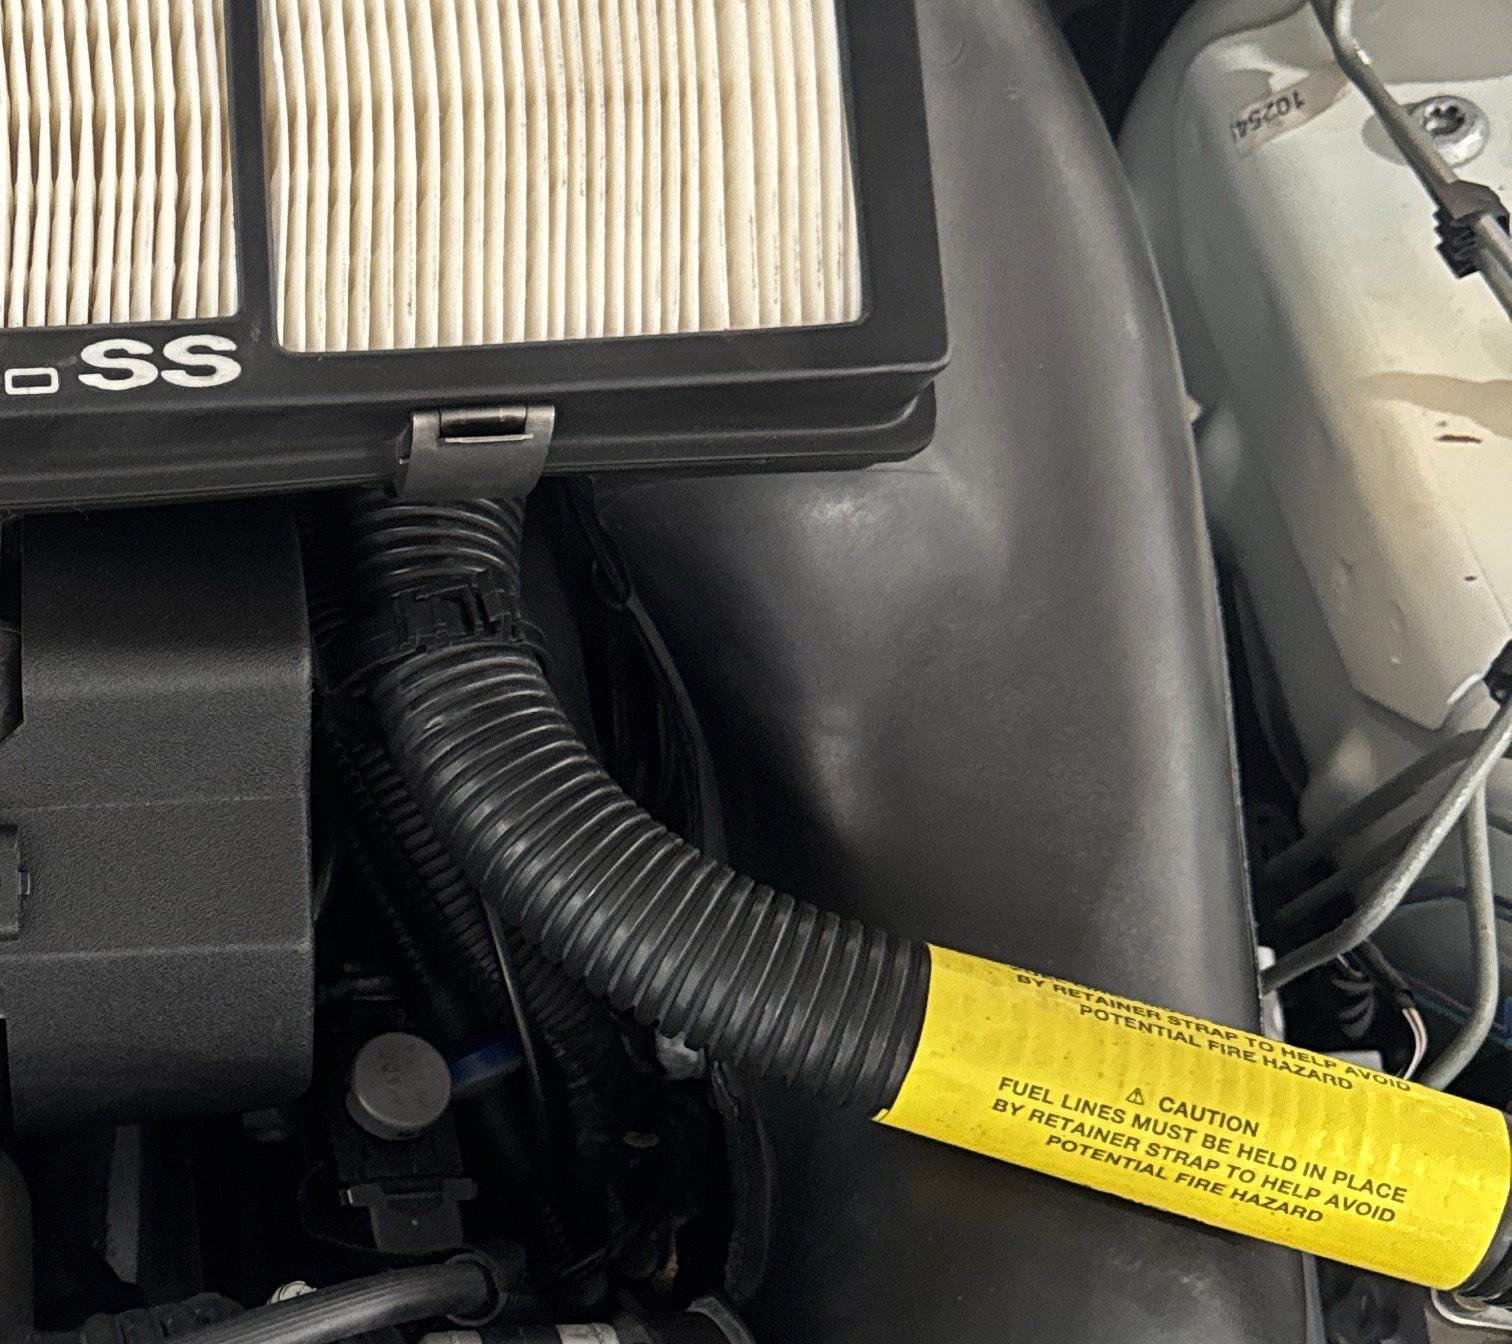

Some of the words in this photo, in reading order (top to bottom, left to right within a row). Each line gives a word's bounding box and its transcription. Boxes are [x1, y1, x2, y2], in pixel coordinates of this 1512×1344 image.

[78, 334, 243, 391] SS
[1016, 973, 1047, 989] BY
[1053, 983, 1161, 1021] RETAINER
[1167, 1014, 1238, 1042] STRAP
[1245, 1036, 1274, 1053] TO
[1281, 1046, 1337, 1070] HELP
[1345, 1065, 1412, 1092] AVOID
[1079, 1003, 1202, 1048] POTENTIAL
[1207, 1039, 1257, 1064] FIRE
[1263, 1056, 1353, 1091] HAZARD
[992, 1097, 1026, 1117] BY
[1028, 1108, 1141, 1152] RETAINER
[1145, 1141, 1221, 1173] STRAP
[1227, 1163, 1256, 1184] TO
[1260, 1173, 1322, 1202] HELP
[1324, 1193, 1397, 1224] AVOID
[998, 1076, 1054, 1105] FUEL
[1060, 1093, 1127, 1125] LINES
[1130, 1113, 1198, 1144] MUST
[1201, 1132, 1233, 1155] BE
[1237, 1143, 1297, 1173] HELD
[1303, 1161, 1328, 1181] IN
[1332, 1169, 1409, 1204] PLACE
[1158, 1095, 1260, 1138] CAUTION
[1045, 1134, 1169, 1181] POTENTIAL
[1174, 1172, 1227, 1196] FIRE
[1229, 1186, 1324, 1224] HAZARD
